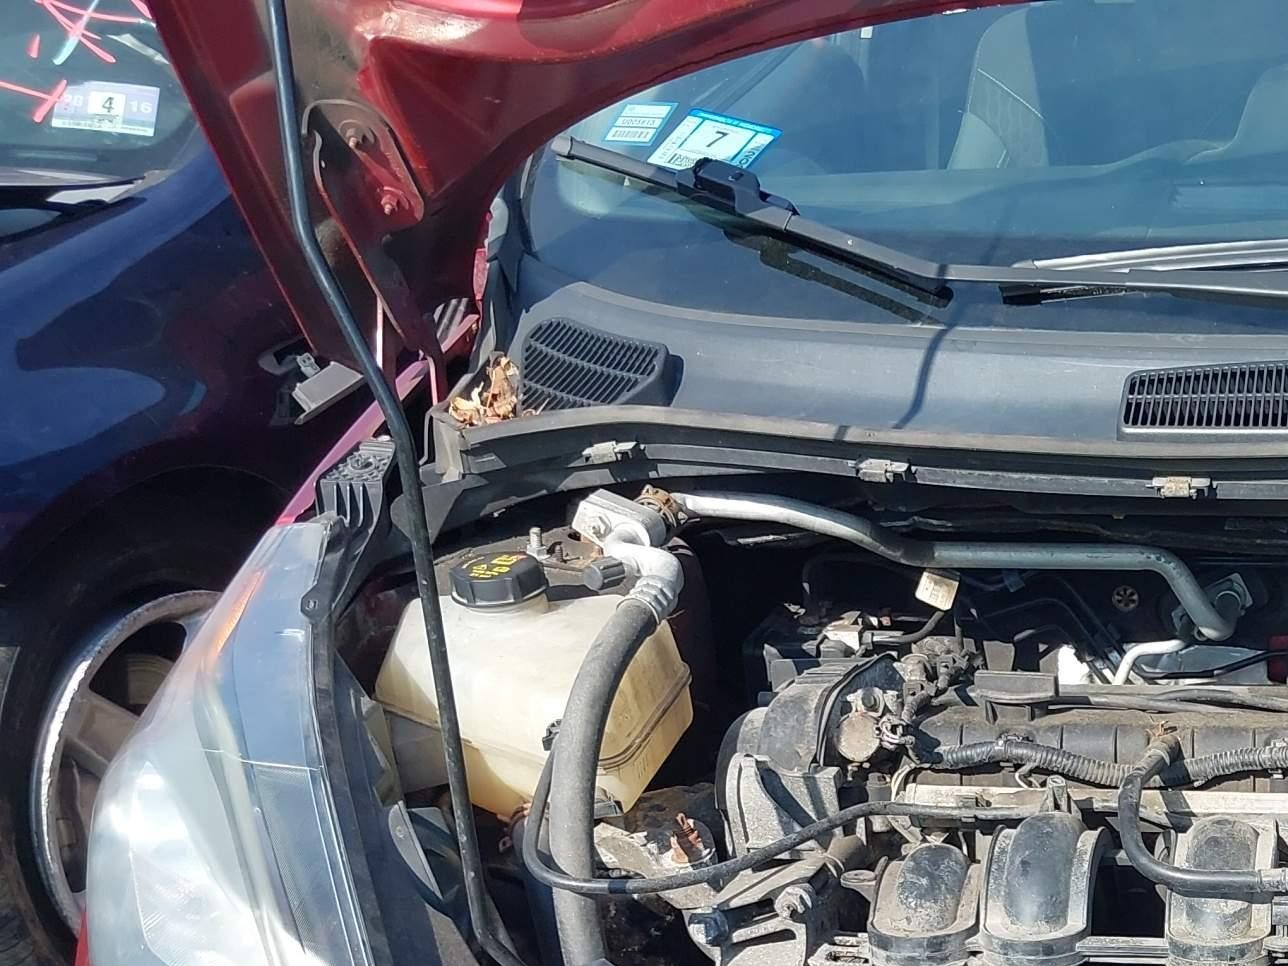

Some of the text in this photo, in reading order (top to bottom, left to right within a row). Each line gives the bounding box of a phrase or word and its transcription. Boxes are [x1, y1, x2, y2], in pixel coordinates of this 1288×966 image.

[101, 96, 115, 113] 4
[129, 100, 153, 114] 16
[705, 130, 730, 148] 7
